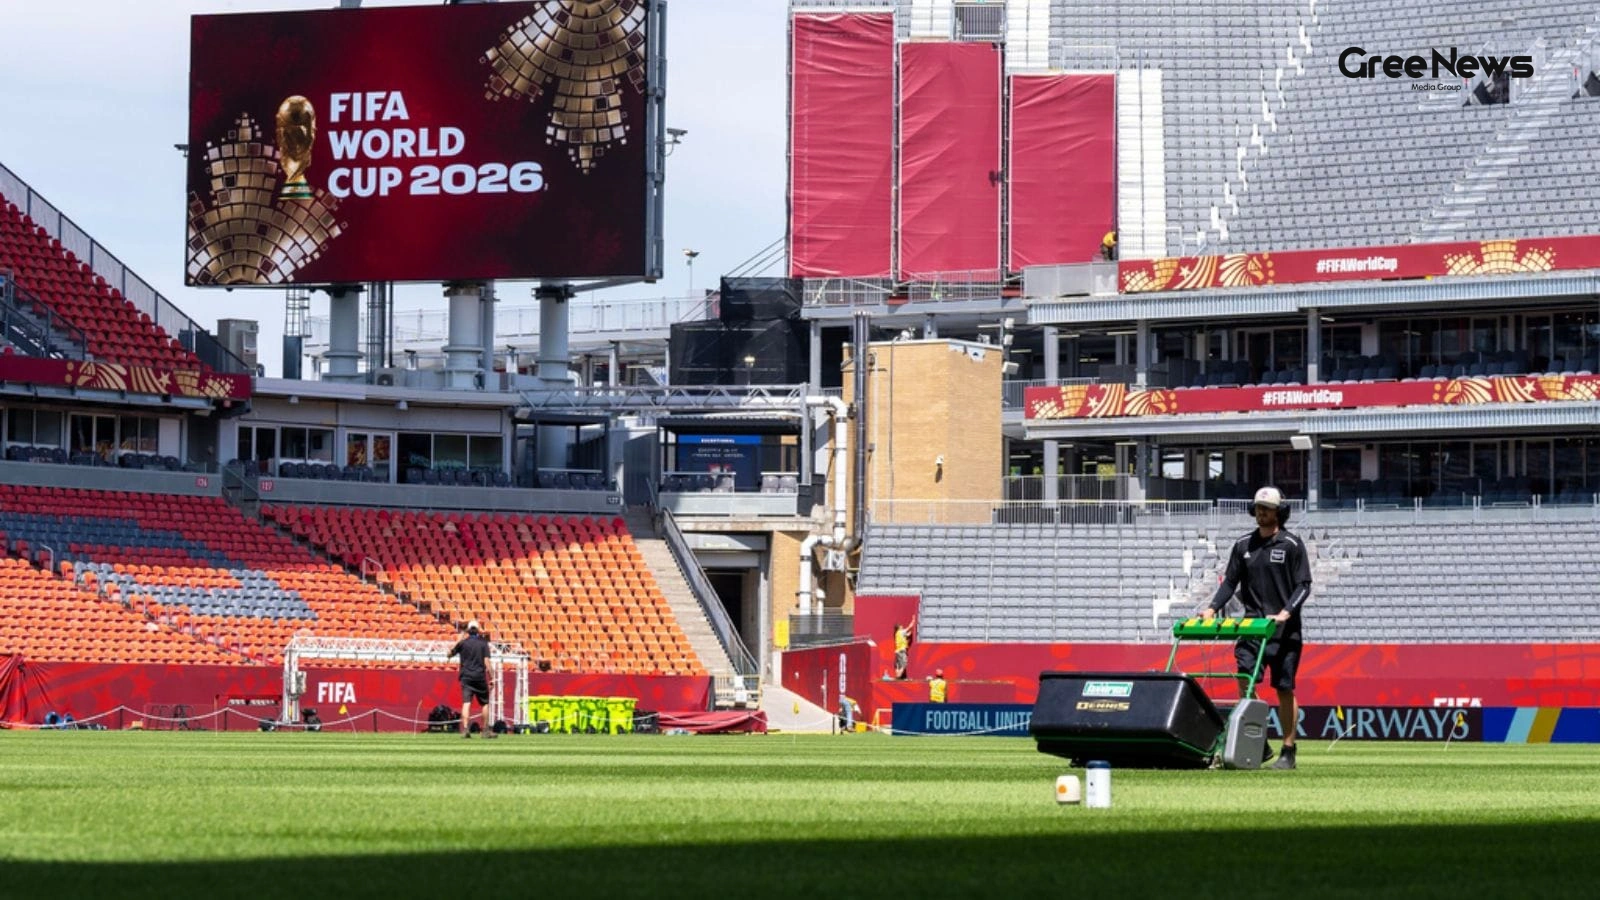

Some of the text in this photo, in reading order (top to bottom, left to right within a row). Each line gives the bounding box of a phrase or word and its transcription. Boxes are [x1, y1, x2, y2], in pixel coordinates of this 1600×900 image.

[330, 91, 410, 122] FIFA
[328, 127, 465, 160] WORLD
[327, 161, 544, 198] CUP 2026
[1316, 256, 1398, 273] #FIFAWorldCup
[1262, 389, 1343, 406] #FIFAWorldCup
[318, 682, 357, 703] FIFA
[1076, 701, 1130, 711] DENNIS
[925, 710, 991, 730] FOOTBALL
[1321, 707, 1470, 739] AIRWAYS
